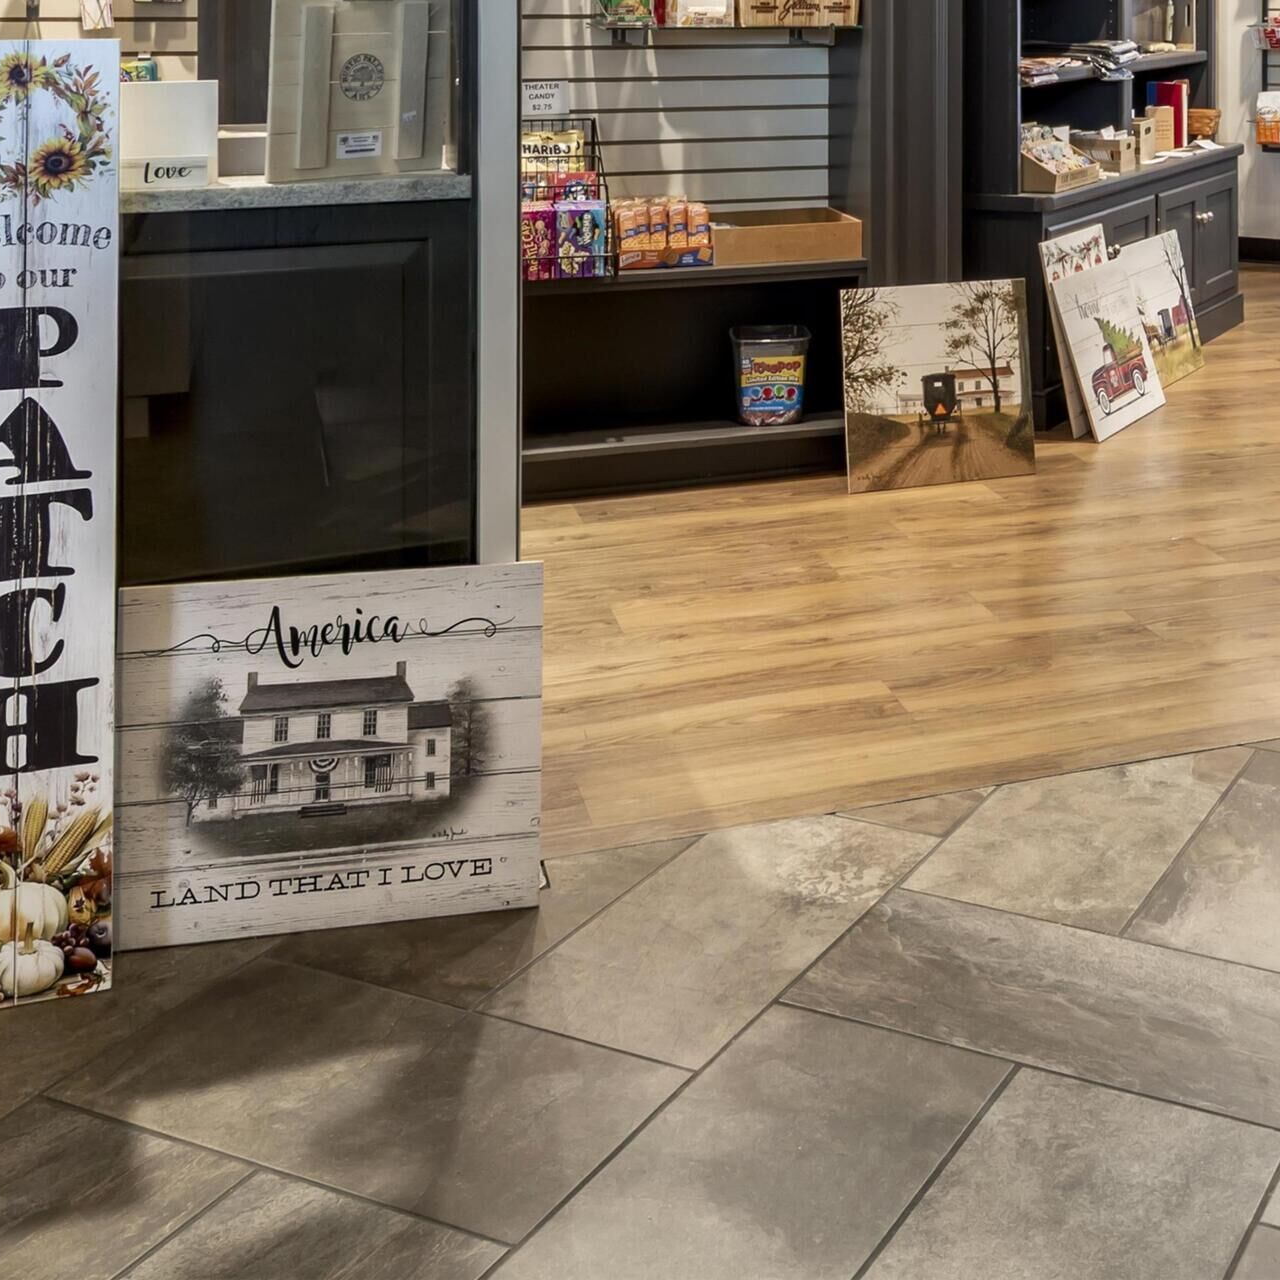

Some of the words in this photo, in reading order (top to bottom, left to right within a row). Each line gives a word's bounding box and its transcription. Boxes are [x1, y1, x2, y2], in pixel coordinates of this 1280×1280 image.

[524, 83, 560, 91] THEATER
[528, 92, 555, 101] CANDY
[144, 162, 193, 184] Love
[16, 266, 78, 291] our
[245, 606, 410, 669] America
[150, 880, 261, 909] LAND
[269, 870, 370, 897] THAT
[378, 868, 393, 886] I
[400, 857, 493, 883] LOVE
